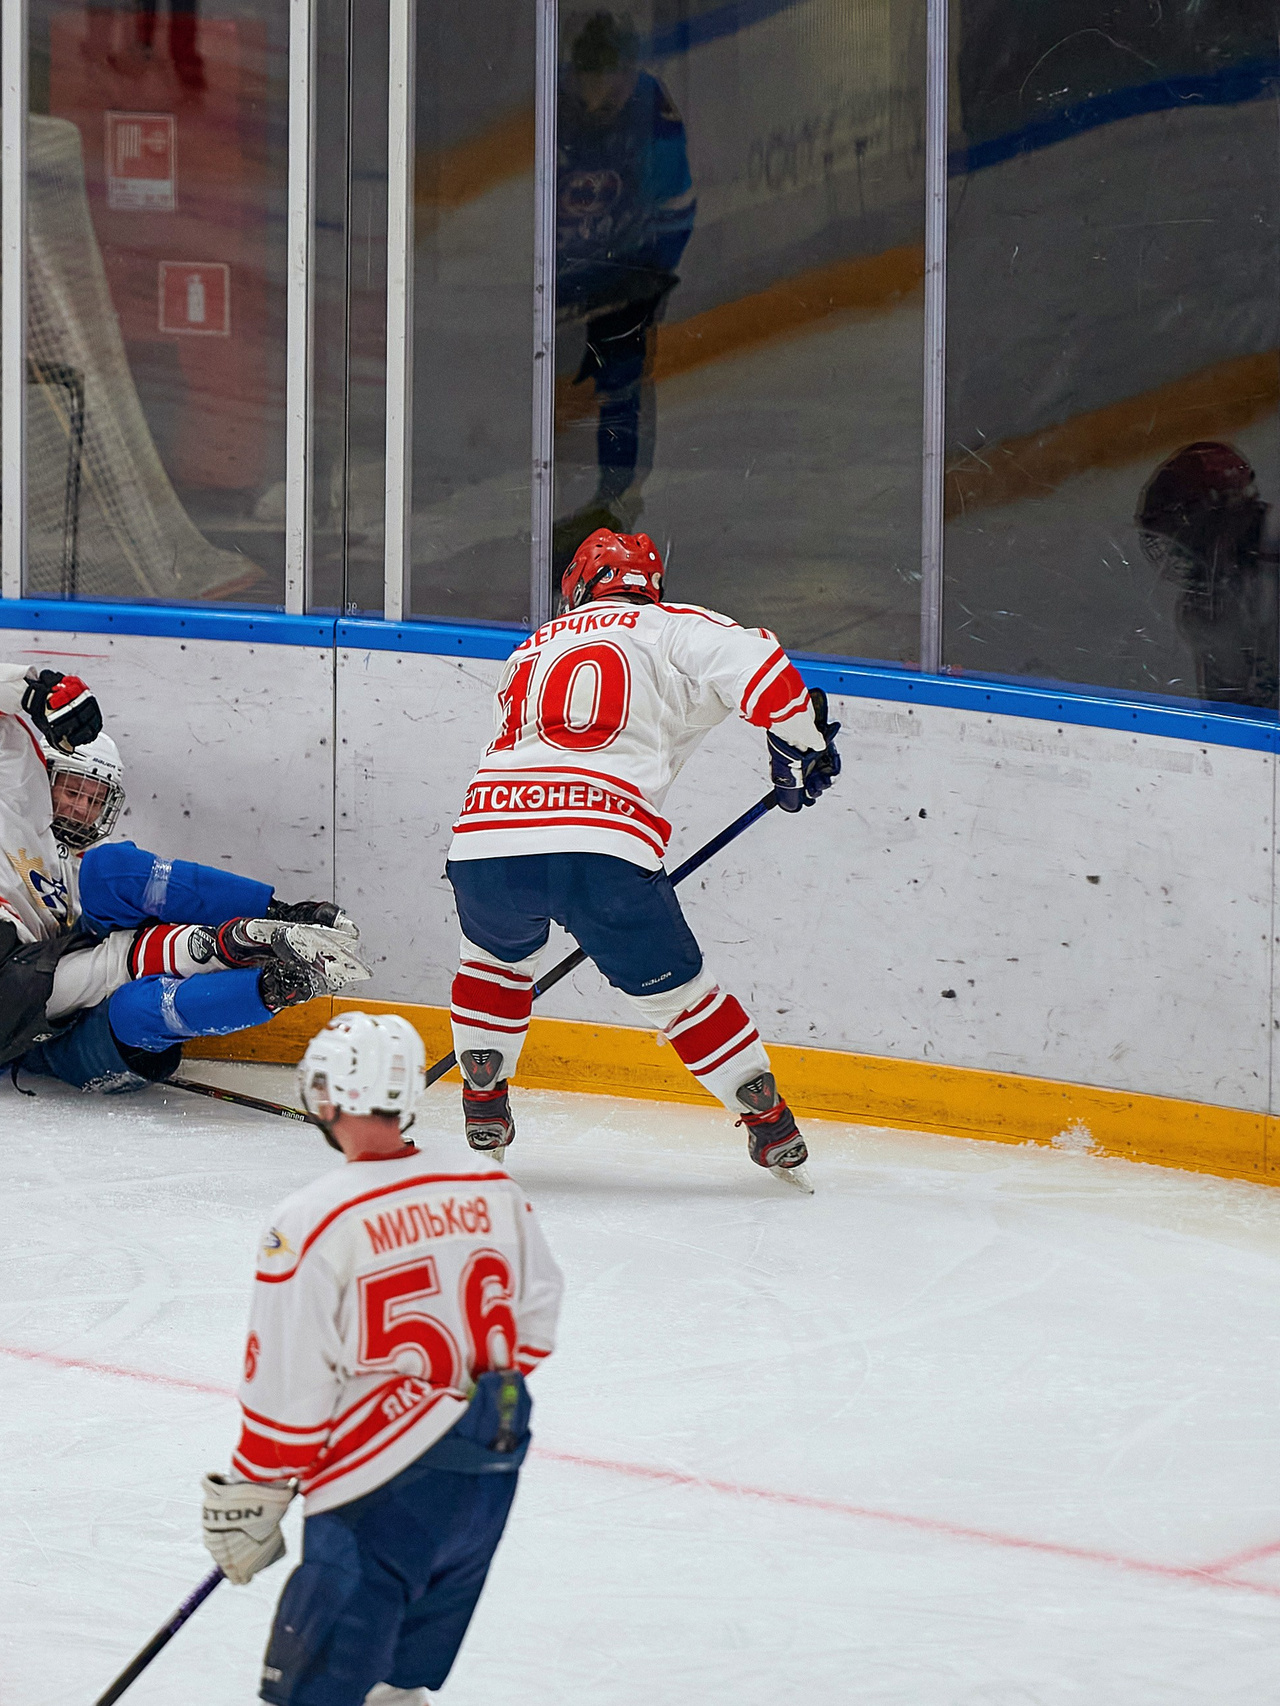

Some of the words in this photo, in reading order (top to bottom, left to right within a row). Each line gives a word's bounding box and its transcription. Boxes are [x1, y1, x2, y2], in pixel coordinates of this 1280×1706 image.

[486, 639, 632, 757] 10
[363, 1196, 493, 1256] МИЛЬКОВ
[354, 1247, 518, 1389] 56
